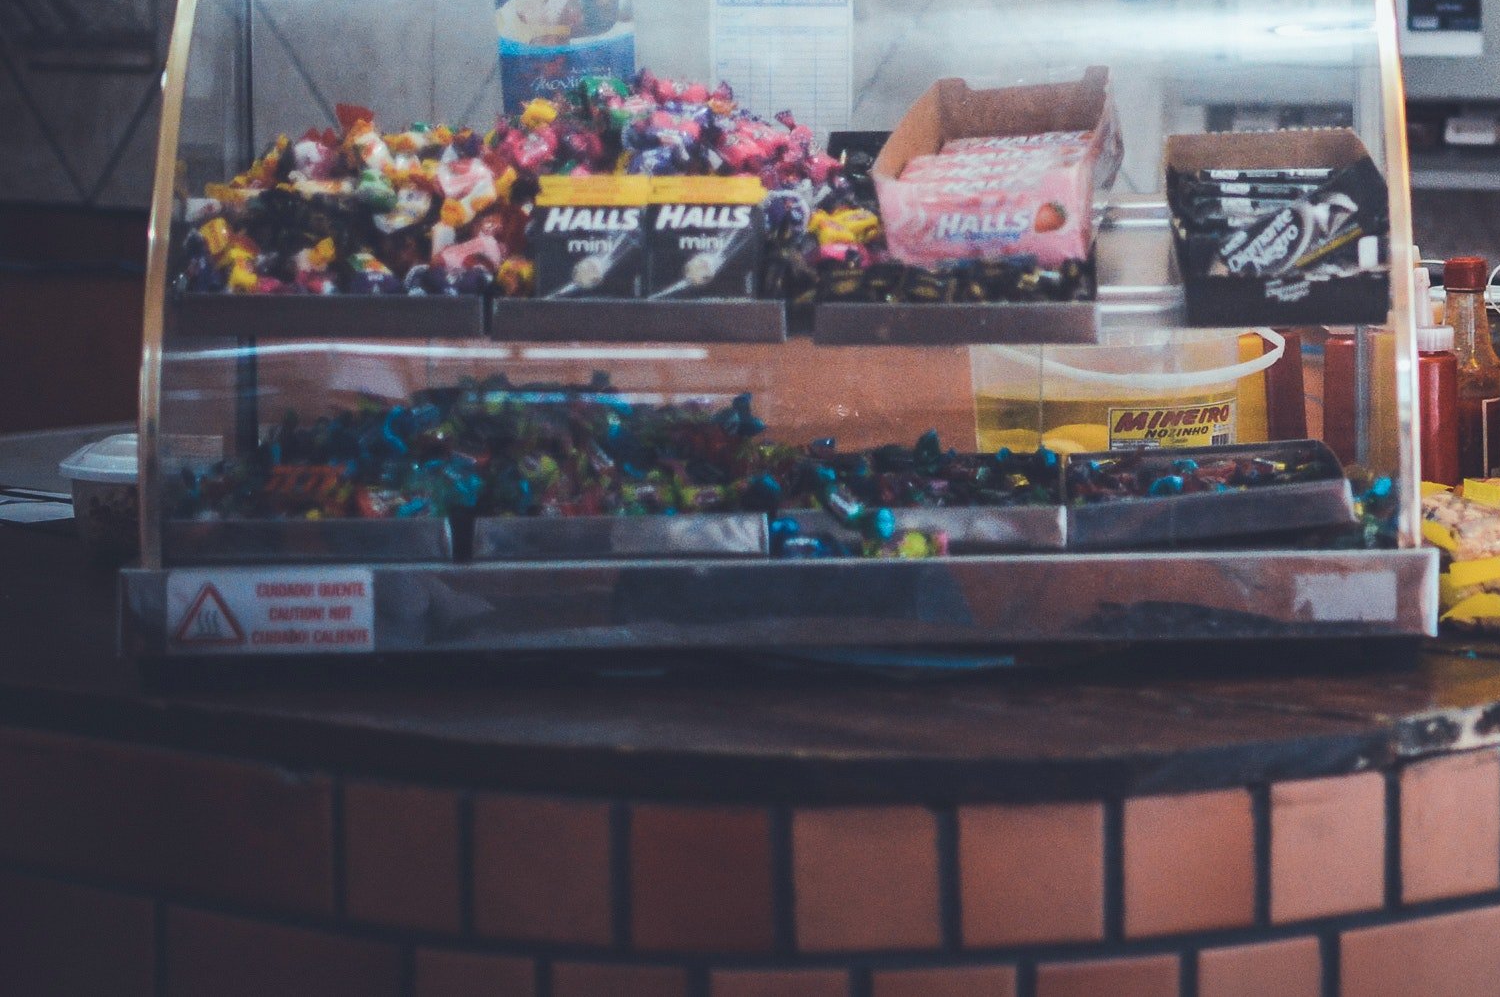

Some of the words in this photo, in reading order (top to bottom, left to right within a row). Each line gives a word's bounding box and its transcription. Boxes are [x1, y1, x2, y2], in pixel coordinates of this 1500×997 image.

[544, 206, 641, 233] HALLS
[655, 204, 752, 230] HALLS
[936, 208, 1033, 240] HALLS
[1113, 404, 1231, 434] MINEIRO
[1144, 425, 1210, 439] NOZINHO
